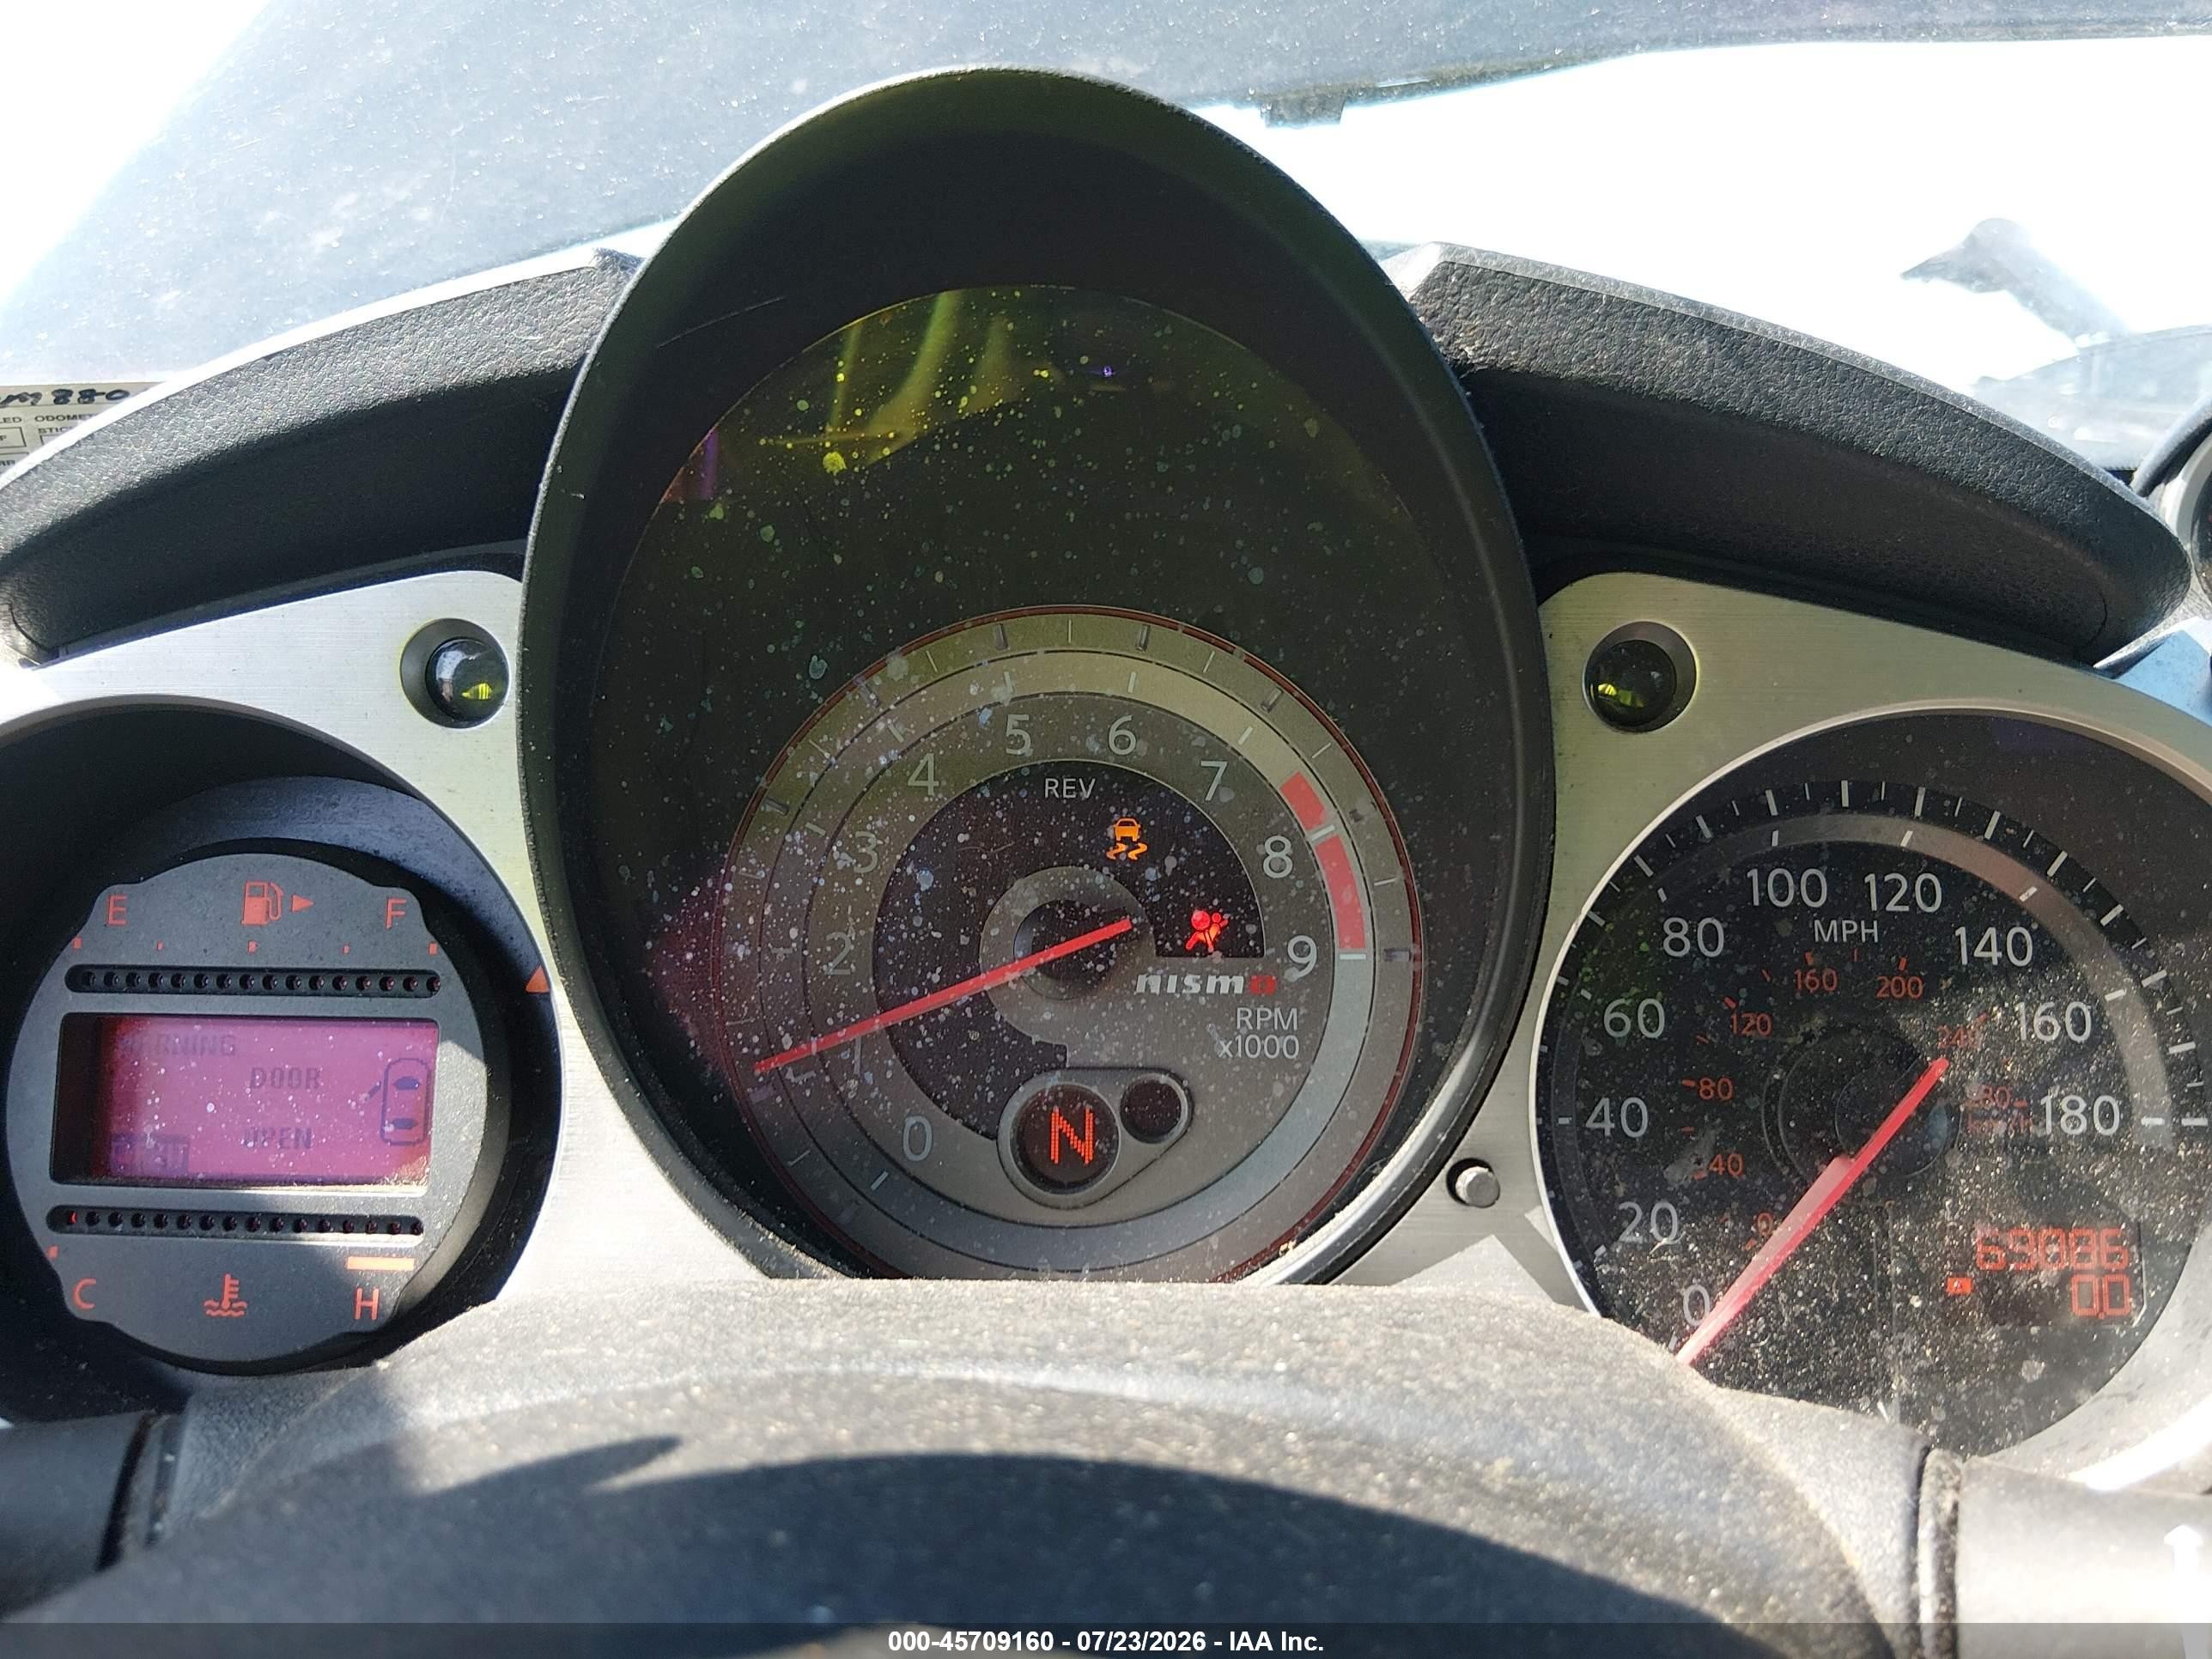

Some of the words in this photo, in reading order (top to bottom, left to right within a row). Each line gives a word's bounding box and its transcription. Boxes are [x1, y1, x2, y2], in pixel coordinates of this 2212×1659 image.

[1005, 715, 1031, 756] 5
[1108, 717, 1138, 756] 6
[908, 754, 939, 795] 4
[1045, 778, 1097, 799] REV
[1201, 760, 1229, 802] 7
[853, 831, 878, 873] 3
[1263, 837, 1293, 878] 8
[1747, 868, 1828, 908] 100
[1864, 873, 1942, 913] 120
[106, 896, 128, 926] E
[385, 898, 408, 929] F
[1663, 918, 1724, 957] 80
[1814, 920, 1880, 944] MPH
[1954, 927, 2033, 967] 140
[824, 932, 852, 975] 2
[1288, 935, 1317, 978] 9
[1795, 969, 1838, 992] 160
[1876, 976, 1923, 1000] 200
[1237, 1007, 1297, 1030] RPM
[1603, 998, 1665, 1039] 60
[1730, 1012, 1772, 1036] 120
[2016, 1001, 2092, 1042] 160
[250, 1066, 323, 1090] DOOR
[1698, 1079, 1733, 1101] 80
[1051, 1106, 1095, 1164] N
[1586, 1097, 1648, 1137] 40
[2039, 1096, 2120, 1136] 180
[242, 1127, 313, 1150] OPEN
[902, 1115, 933, 1161] 0
[1709, 1153, 1743, 1176] 40
[1619, 1202, 1679, 1245] 20
[1757, 1212, 1774, 1237] 0
[73, 1279, 96, 1310] C
[355, 1288, 380, 1321] H
[1682, 1284, 1711, 1327] 0
